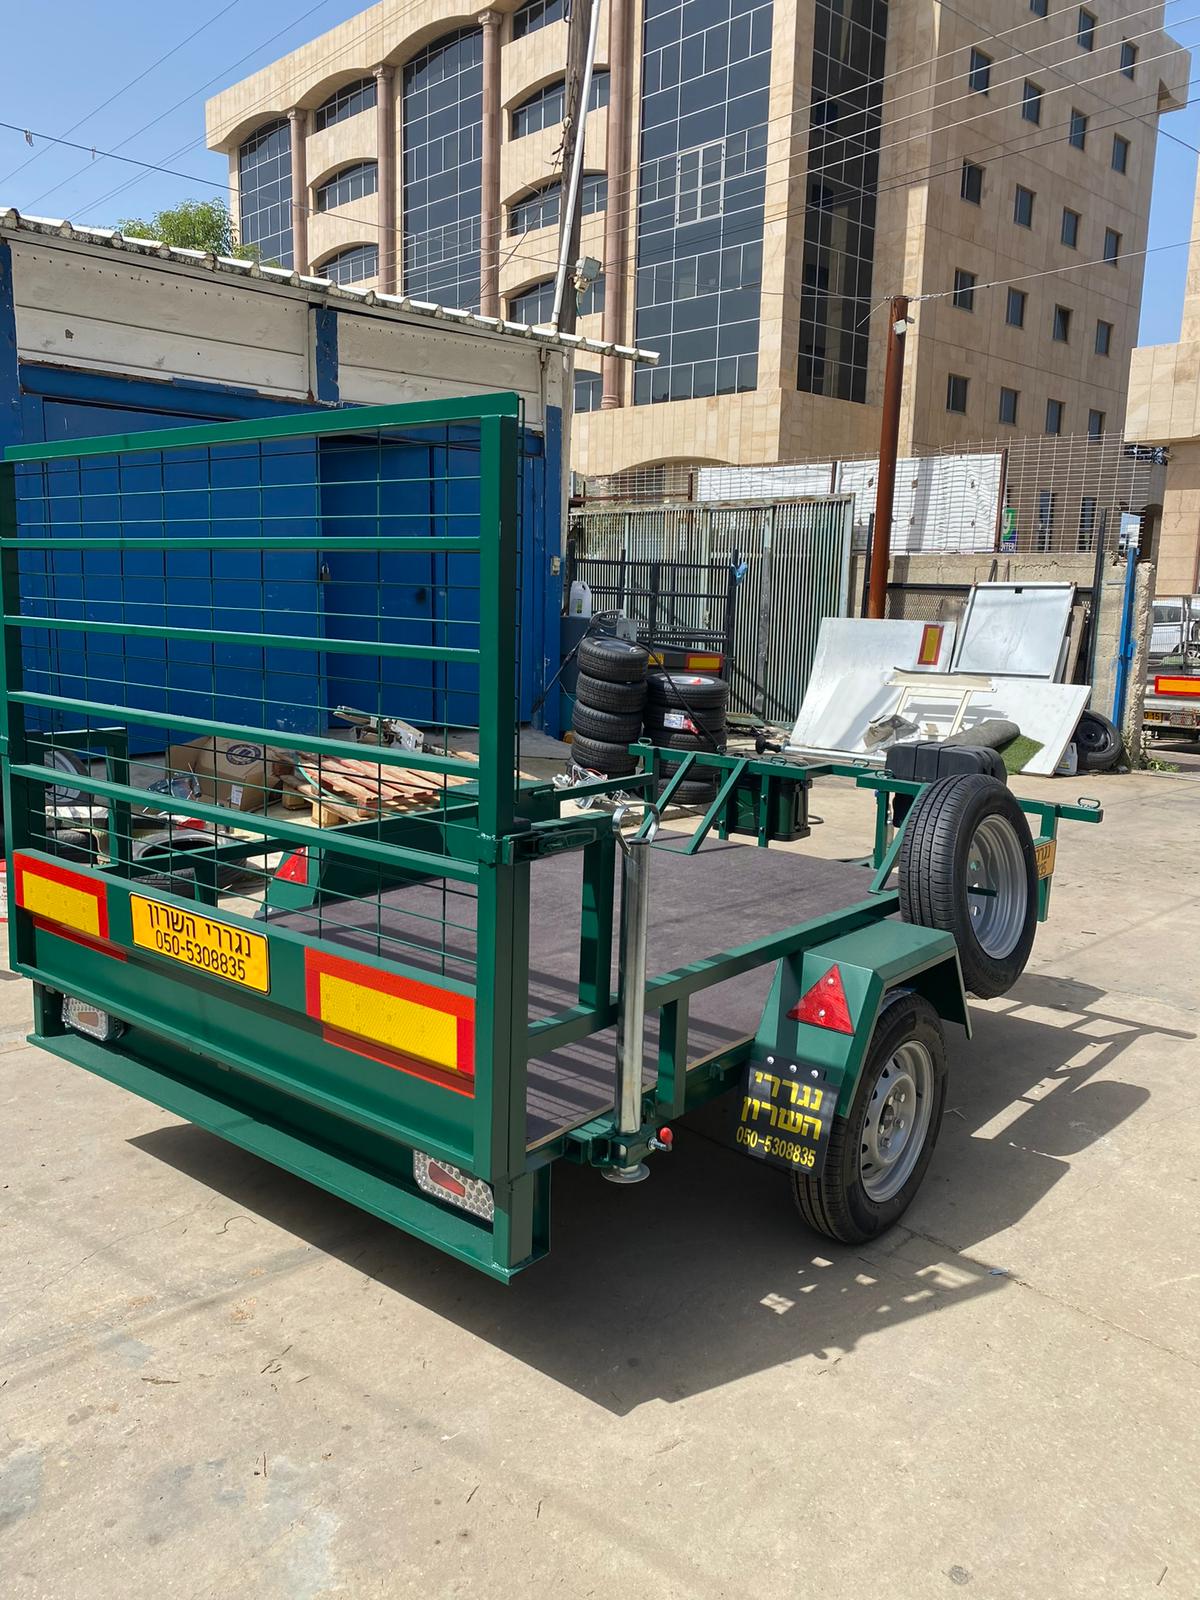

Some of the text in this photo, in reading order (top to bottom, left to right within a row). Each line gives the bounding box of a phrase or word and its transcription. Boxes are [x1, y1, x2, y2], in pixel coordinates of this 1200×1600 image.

[147, 903, 251, 958] נגררי השרון
[155, 929, 246, 981] 050-5308835
[755, 1071, 824, 1111] נגררי
[740, 1096, 823, 1141] השרון
[736, 1126, 816, 1168] 050-5308835
